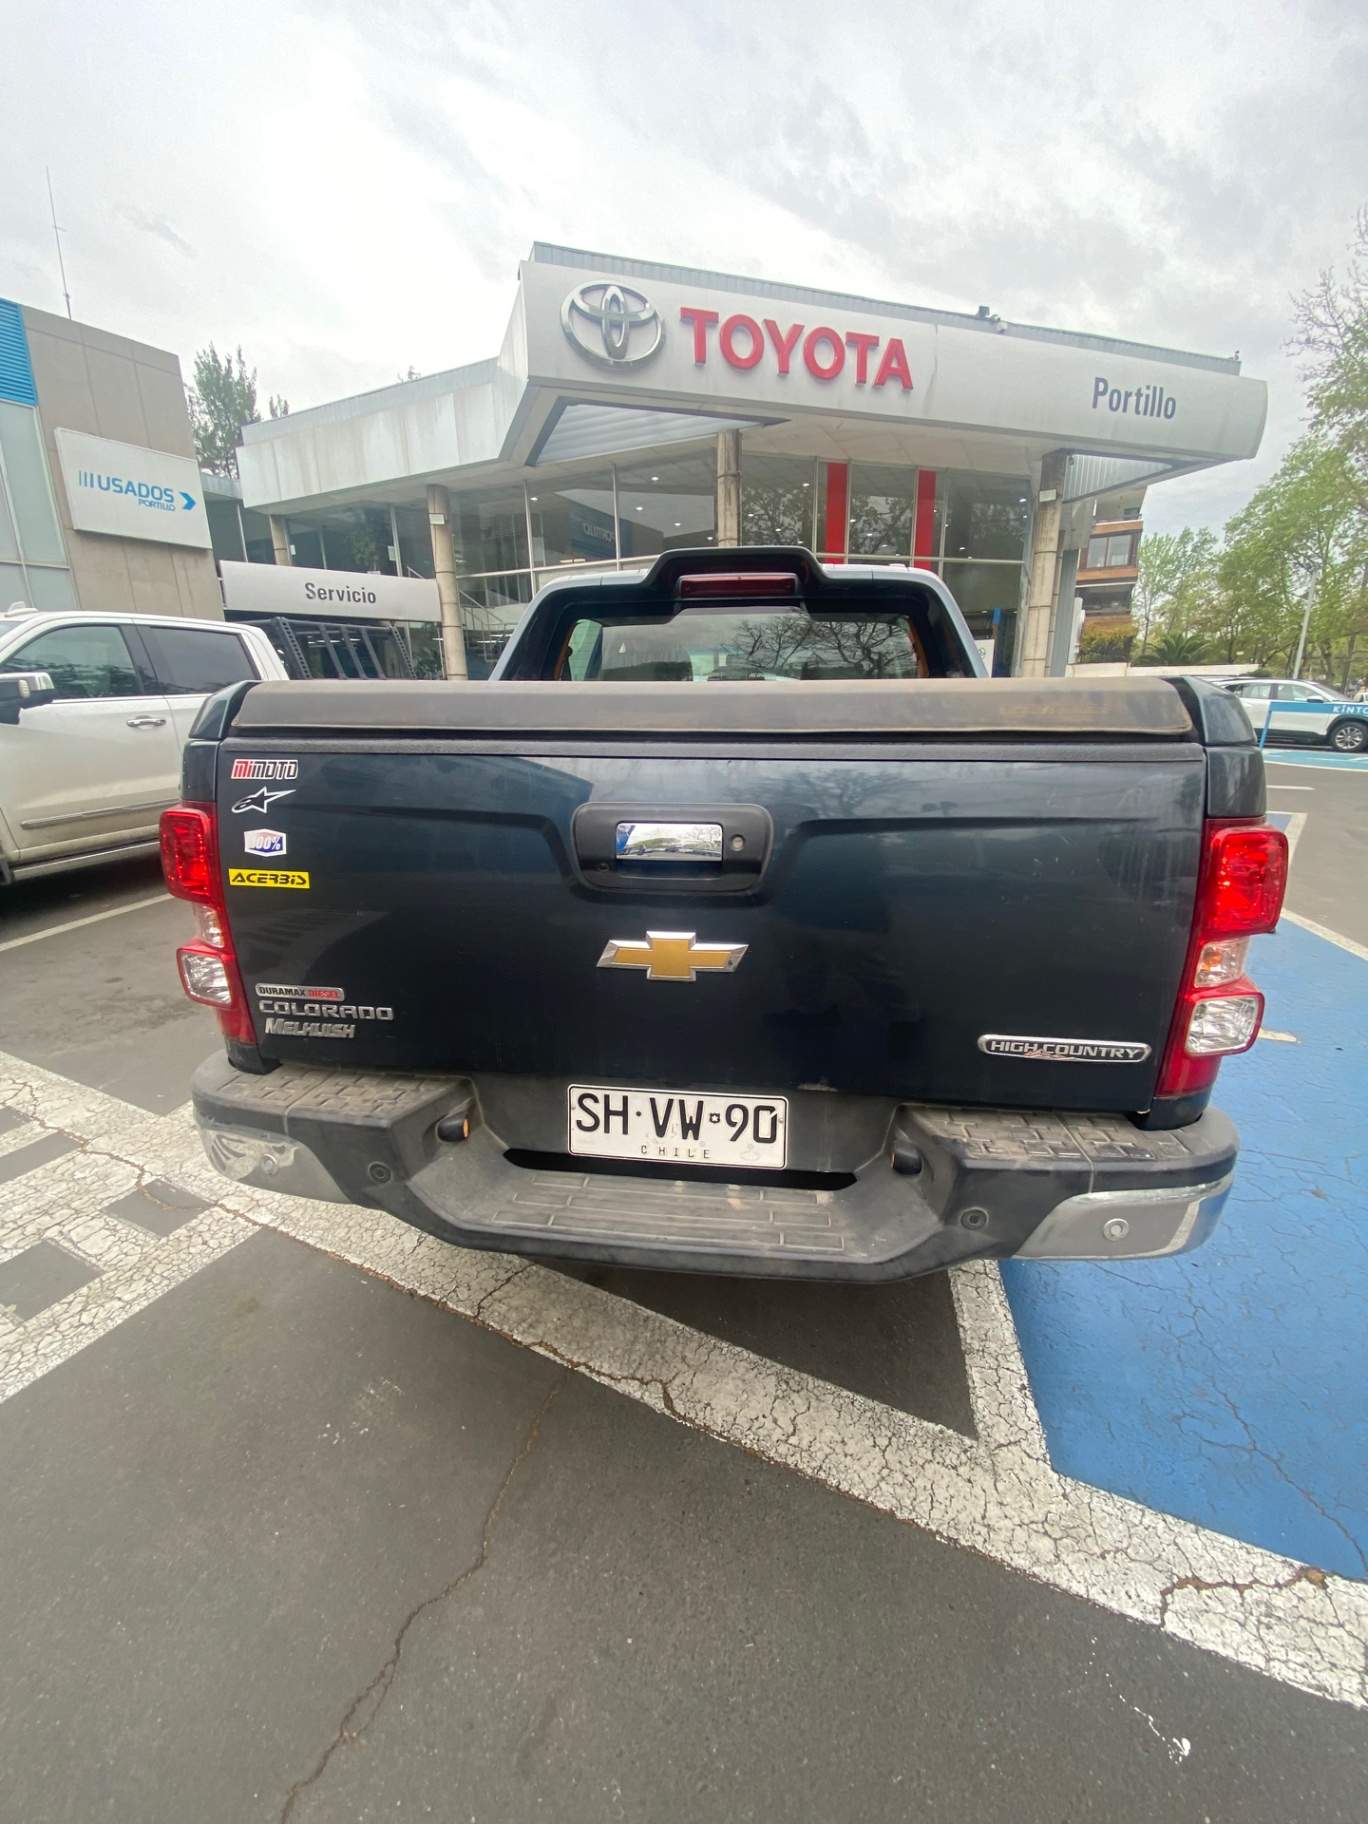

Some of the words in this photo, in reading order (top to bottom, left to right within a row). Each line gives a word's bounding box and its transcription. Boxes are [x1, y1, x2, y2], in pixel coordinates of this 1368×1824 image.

[680, 306, 914, 391] TOYOTA
[1091, 376, 1177, 420] Portillo
[97, 473, 175, 504] USADOS
[304, 582, 377, 604] Servicio
[249, 835, 281, 850] 00%
[259, 986, 305, 997] DURAMAX
[258, 999, 395, 1021] COLORADO
[990, 1040, 1039, 1053] HIGH
[1042, 1042, 1141, 1059] COUNTRY
[640, 1144, 713, 1159] CHILE
